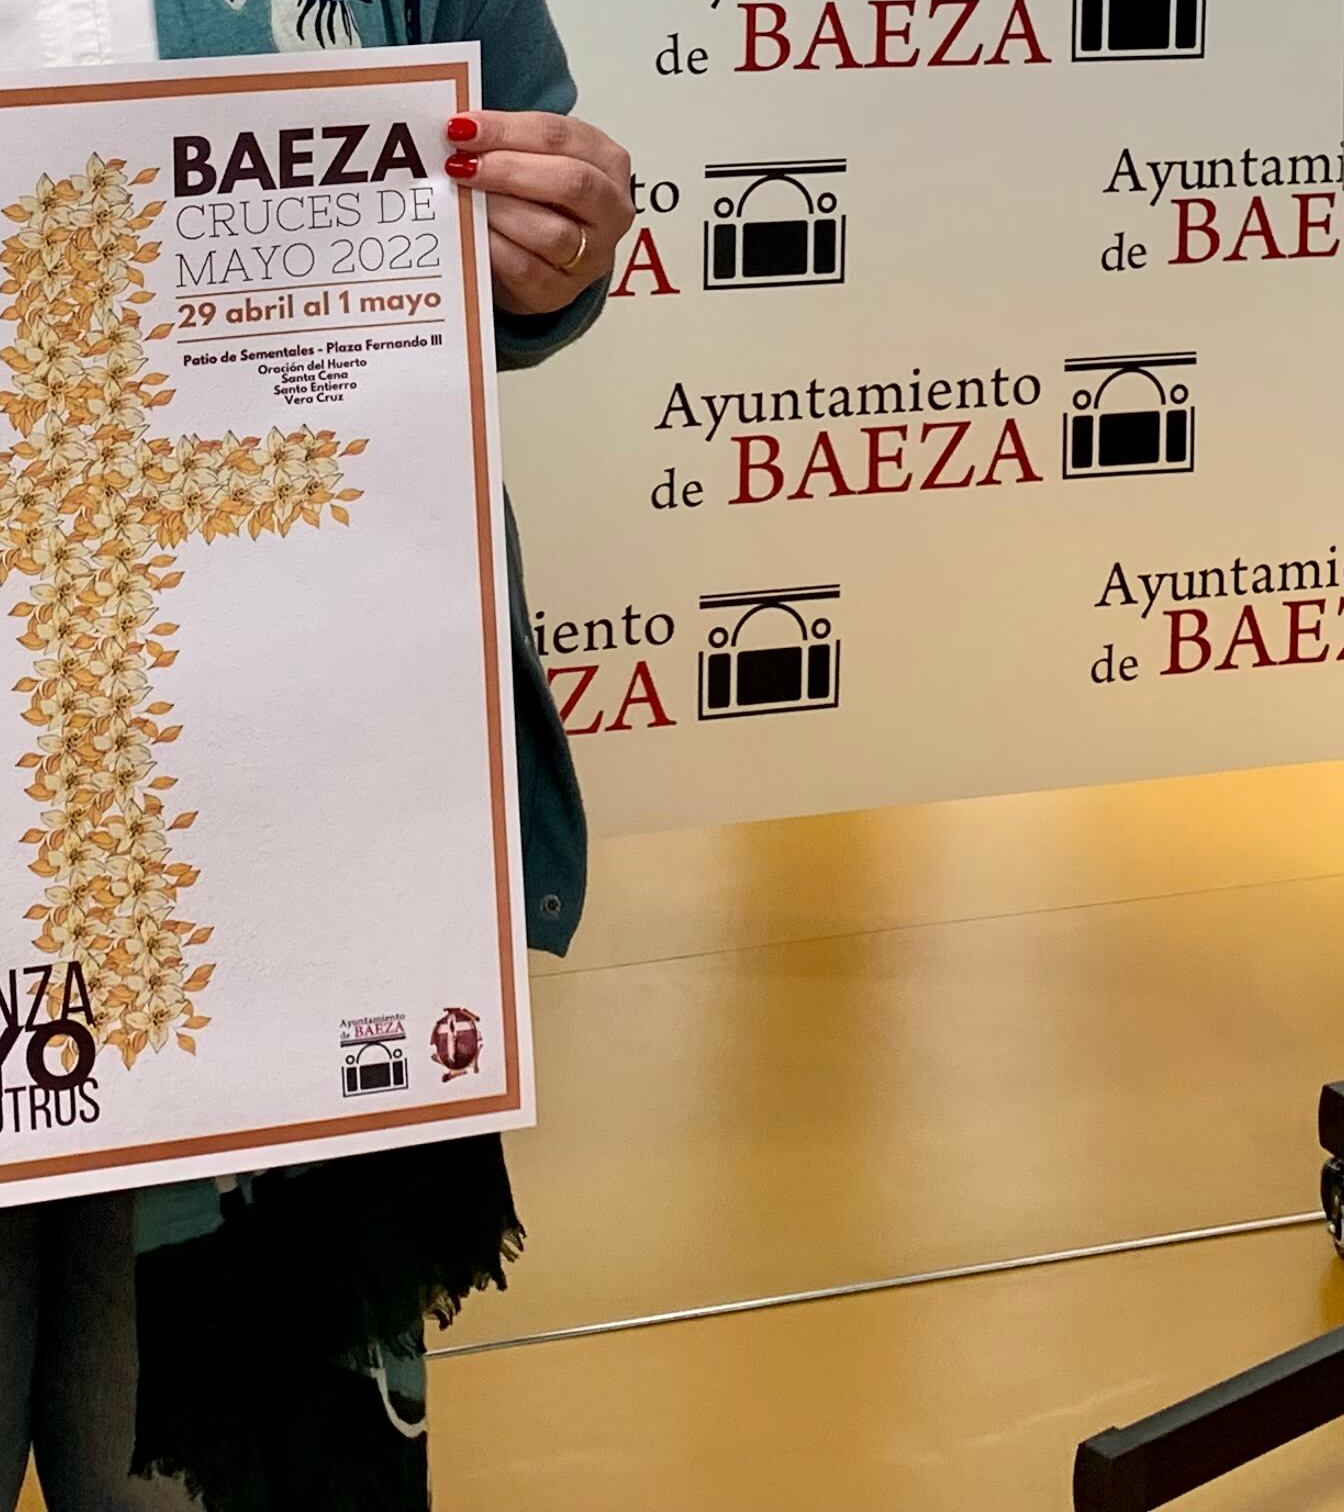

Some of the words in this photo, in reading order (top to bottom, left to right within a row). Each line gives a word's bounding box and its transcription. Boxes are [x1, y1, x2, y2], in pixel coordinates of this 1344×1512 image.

[655, 32, 710, 76] de
[172, 122, 428, 198] BAEZA
[176, 192, 362, 240] CRUCES
[377, 187, 436, 224] DE
[175, 242, 316, 288] MAYO
[330, 233, 440, 274] 2022
[1101, 232, 1148, 272] de
[177, 301, 216, 329] 29
[225, 294, 293, 325] abril
[303, 290, 330, 317] al
[338, 291, 350, 315] 1
[360, 291, 442, 316] mayo
[183, 353, 218, 367] Patio
[220, 351, 237, 363] de
[240, 344, 315, 362] Sementales
[326, 340, 362, 355] Plaza
[365, 335, 428, 352] Fernando
[430, 334, 442, 346] III
[258, 362, 305, 375] Oración
[307, 359, 325, 371] del
[328, 357, 367, 370] Huerto
[273, 383, 308, 395] Santo
[311, 380, 357, 392] Entierro
[281, 372, 316, 384] Santa
[318, 369, 348, 380] Cena
[284, 394, 314, 405] Vera
[316, 392, 344, 403] Cruz
[654, 367, 1042, 438] Ayuntamiento
[650, 466, 705, 510] de
[728, 416, 1044, 507] BAEZA
[1090, 643, 1140, 685] de
[354, 1021, 405, 1038] BAEZA
